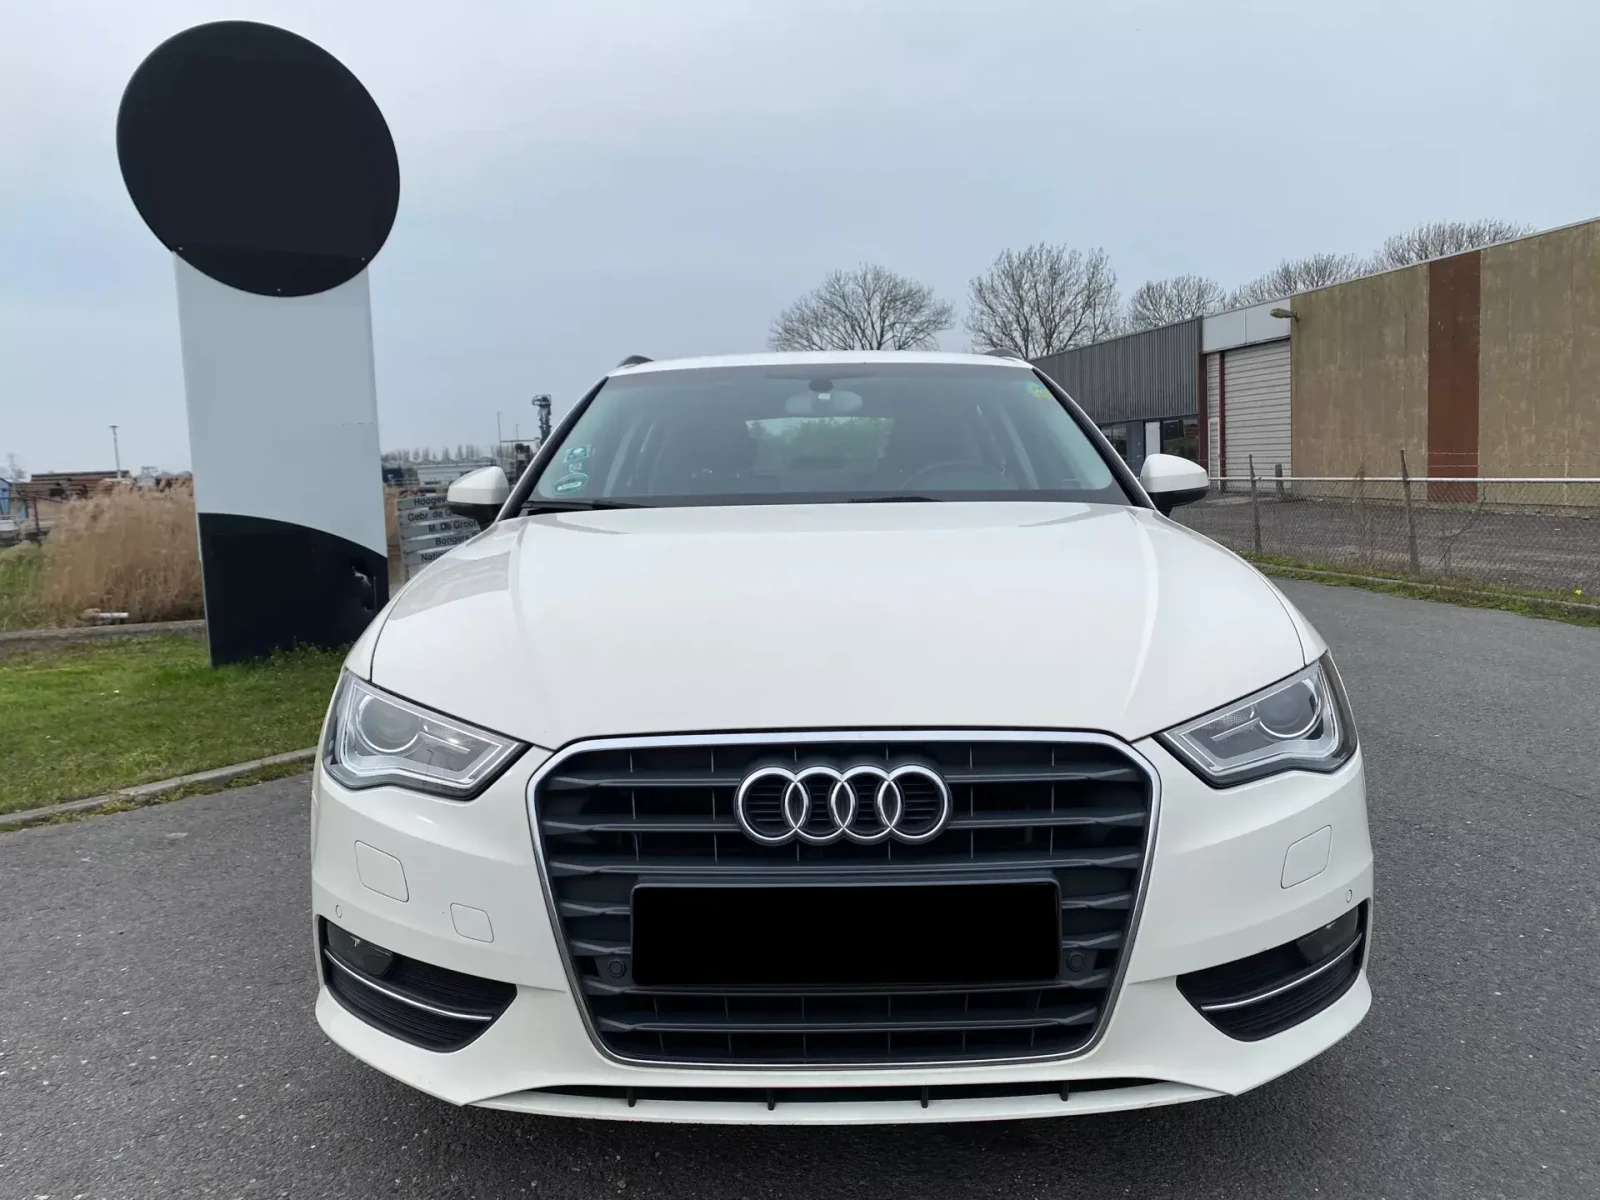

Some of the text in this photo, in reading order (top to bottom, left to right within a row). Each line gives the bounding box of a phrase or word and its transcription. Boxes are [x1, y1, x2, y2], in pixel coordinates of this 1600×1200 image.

[413, 496, 447, 506] Hoogev
[432, 510, 443, 518] de
[440, 522, 452, 531] De
